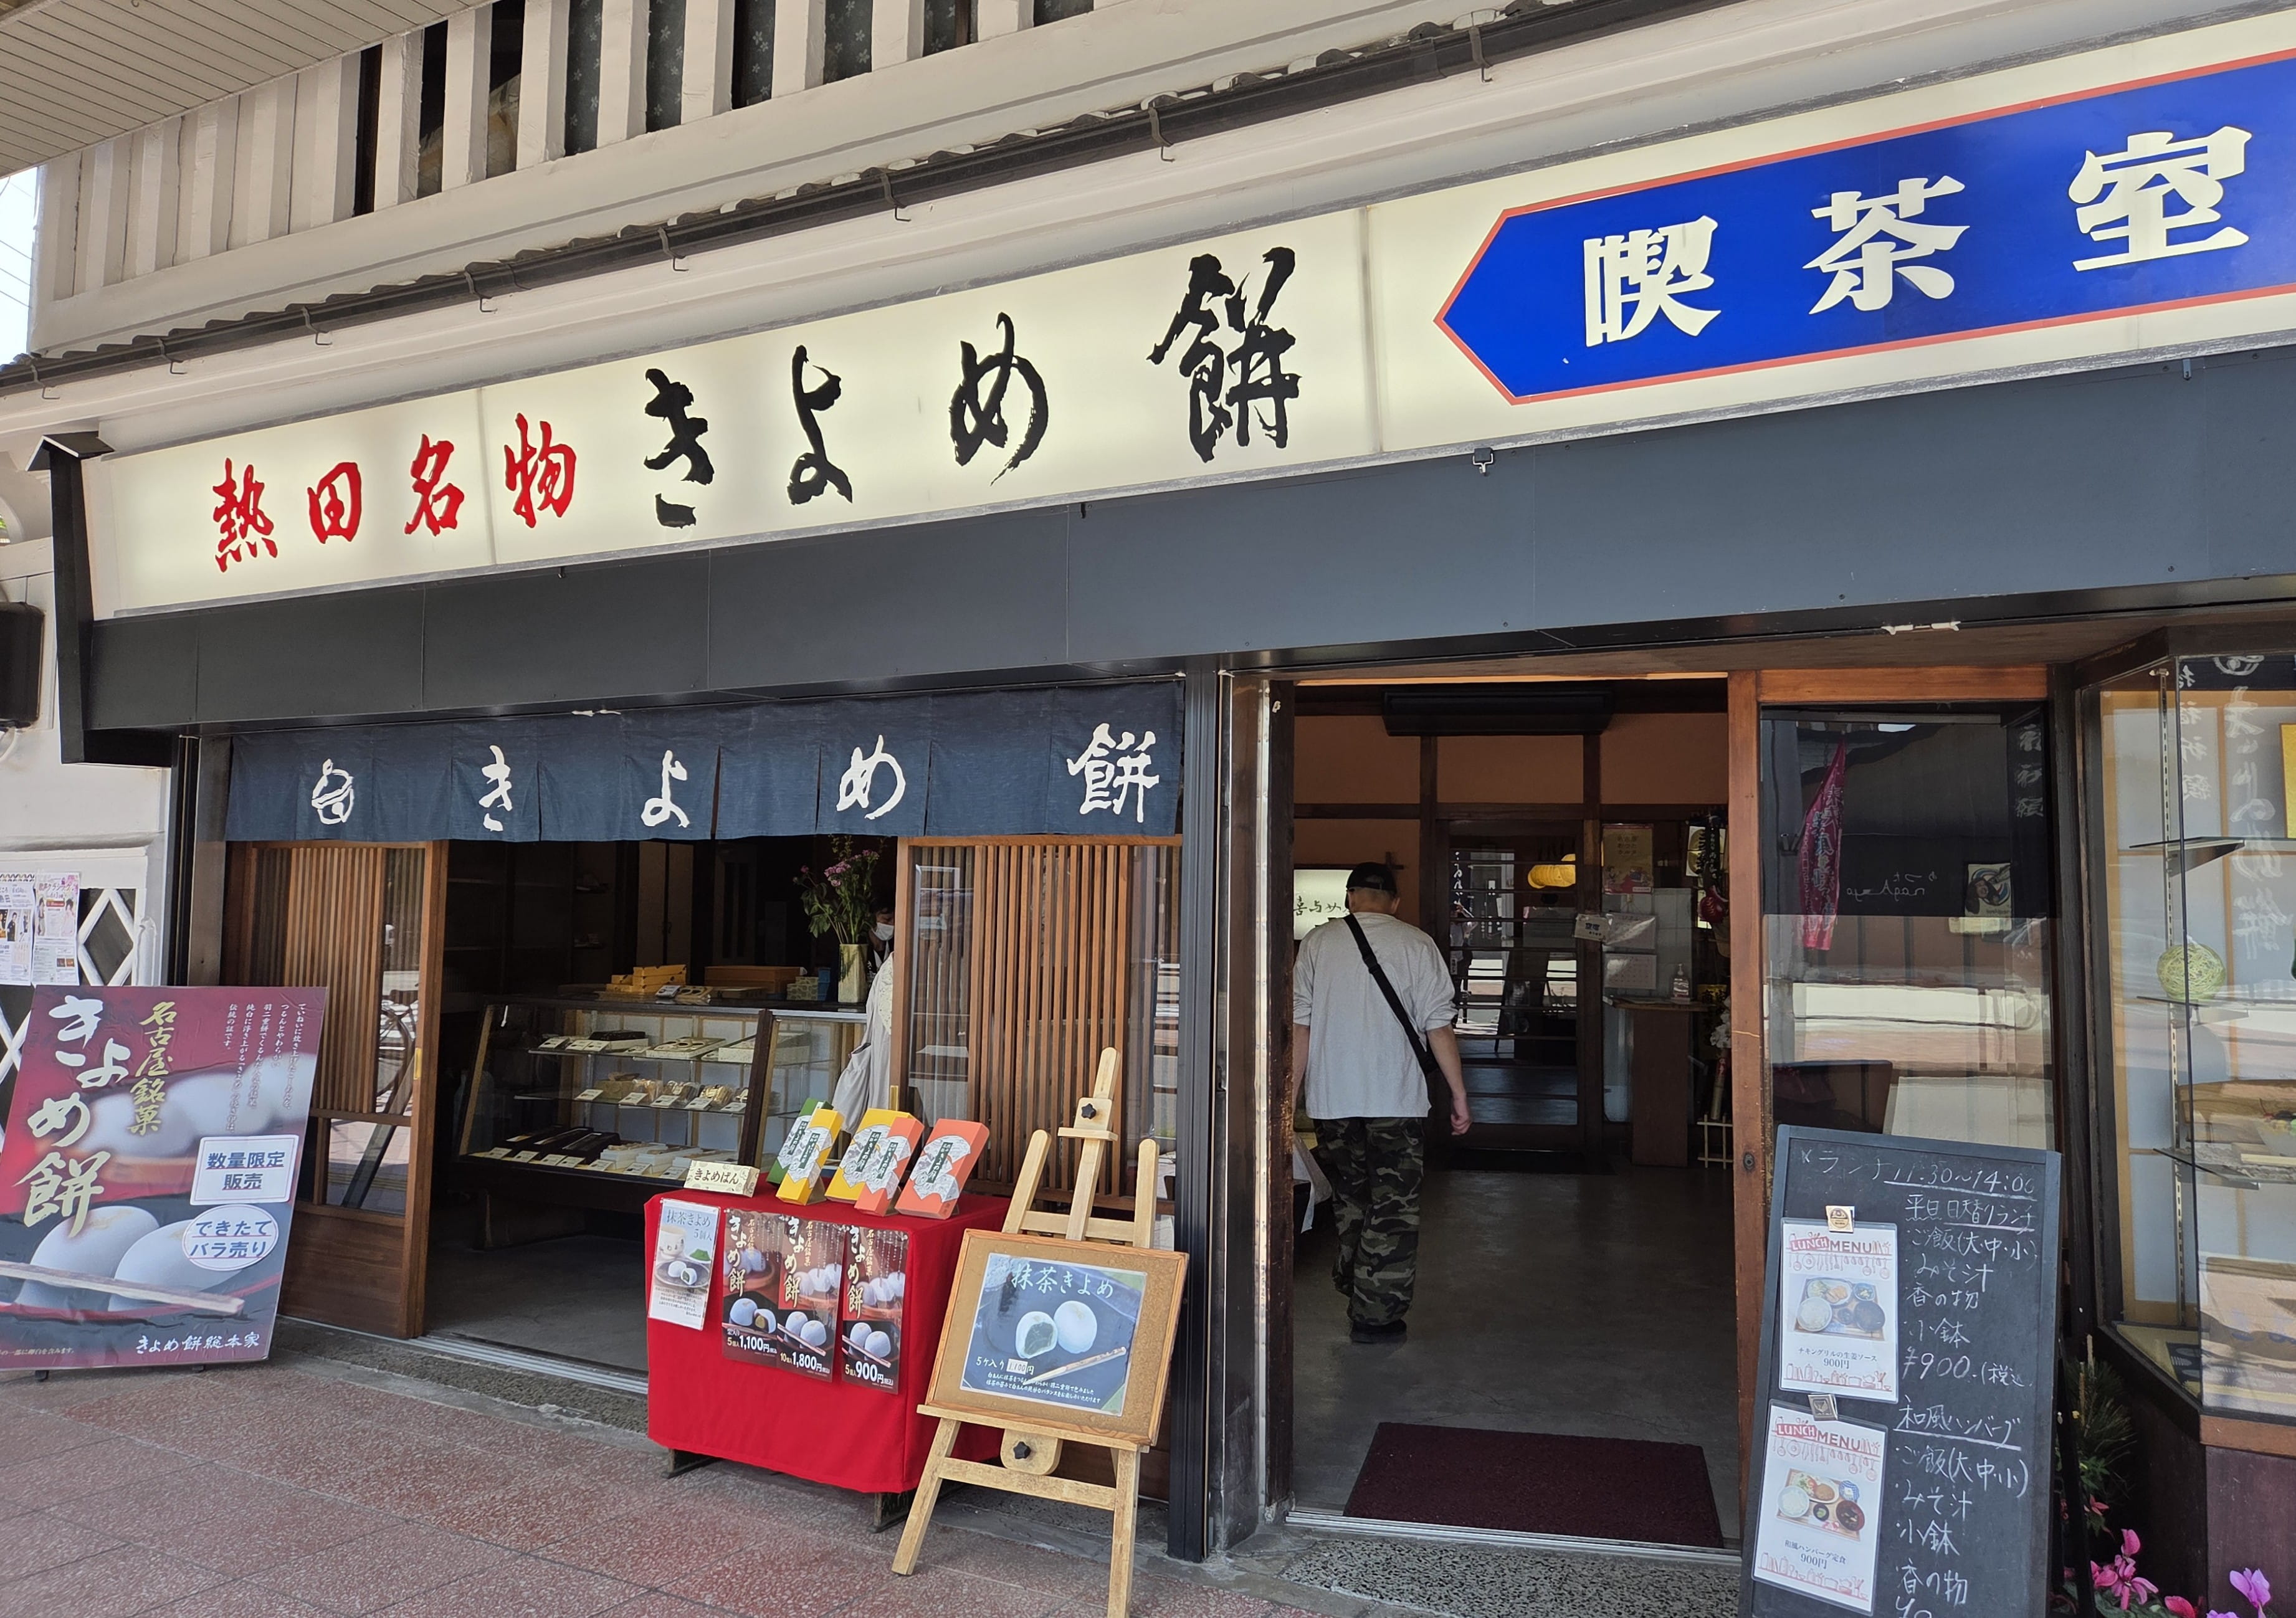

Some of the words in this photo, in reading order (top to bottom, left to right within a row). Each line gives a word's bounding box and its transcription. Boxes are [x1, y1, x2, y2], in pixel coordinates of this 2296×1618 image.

[1583, 126, 2253, 348] 喫茶室
[213, 412, 576, 572] 熱田名物
[643, 246, 1302, 529] きよめ餅
[479, 723, 1160, 832] きよめ餅
[129, 1001, 176, 1136] 名古屋銘菓
[12, 994, 131, 1239] きよめ餅
[207, 1150, 286, 1169] 数量限定
[222, 1172, 262, 1191] 販売
[194, 1219, 273, 1237] できたて
[666, 1209, 712, 1227] 抹茶きよめ
[189, 1238, 268, 1258] バラ売り
[726, 1215, 748, 1297] きよめ餅
[1791, 1237, 1828, 1251] LUNCH
[1830, 1240, 1872, 1254] MENU
[783, 1216, 804, 1308] きよめ餅
[847, 1224, 865, 1320] きよめ餅
[1011, 1263, 1114, 1299] 抹茶きよめ
[135, 1331, 260, 1354] きよめ餅総本家
[1798, 1347, 1878, 1362] チキングリルの生姜ソース
[1823, 1358, 1850, 1369] 900円
[1778, 1424, 1816, 1438] LUNCH
[1817, 1430, 1860, 1451] MENU
[1784, 1539, 1847, 1565] 和風ハンバーグ定食
[1800, 1553, 1827, 1570] 900円
